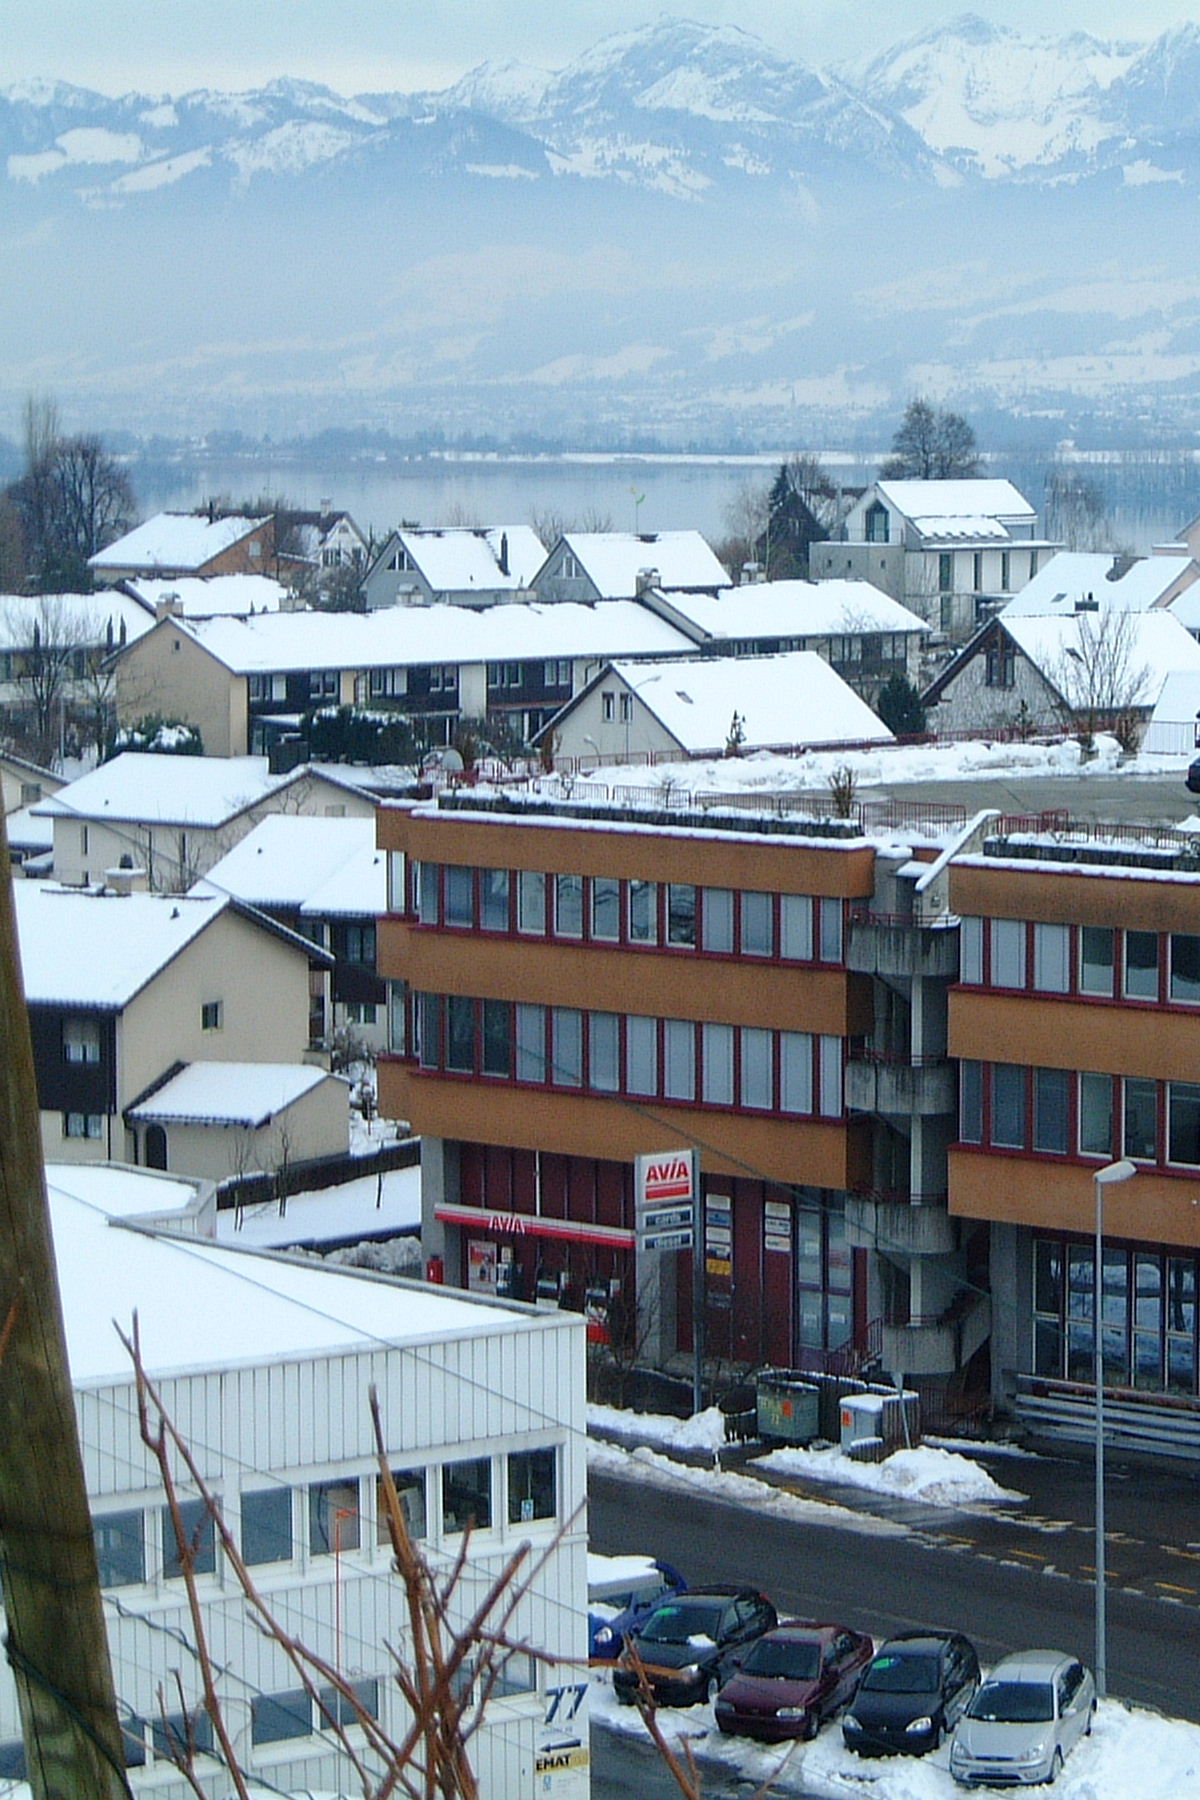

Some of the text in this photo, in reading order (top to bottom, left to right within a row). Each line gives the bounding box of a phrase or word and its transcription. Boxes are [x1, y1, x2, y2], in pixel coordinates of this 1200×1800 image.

[646, 1158, 688, 1182] AVIA
[488, 1213, 525, 1234] AVIA
[545, 1683, 589, 1725] 77
